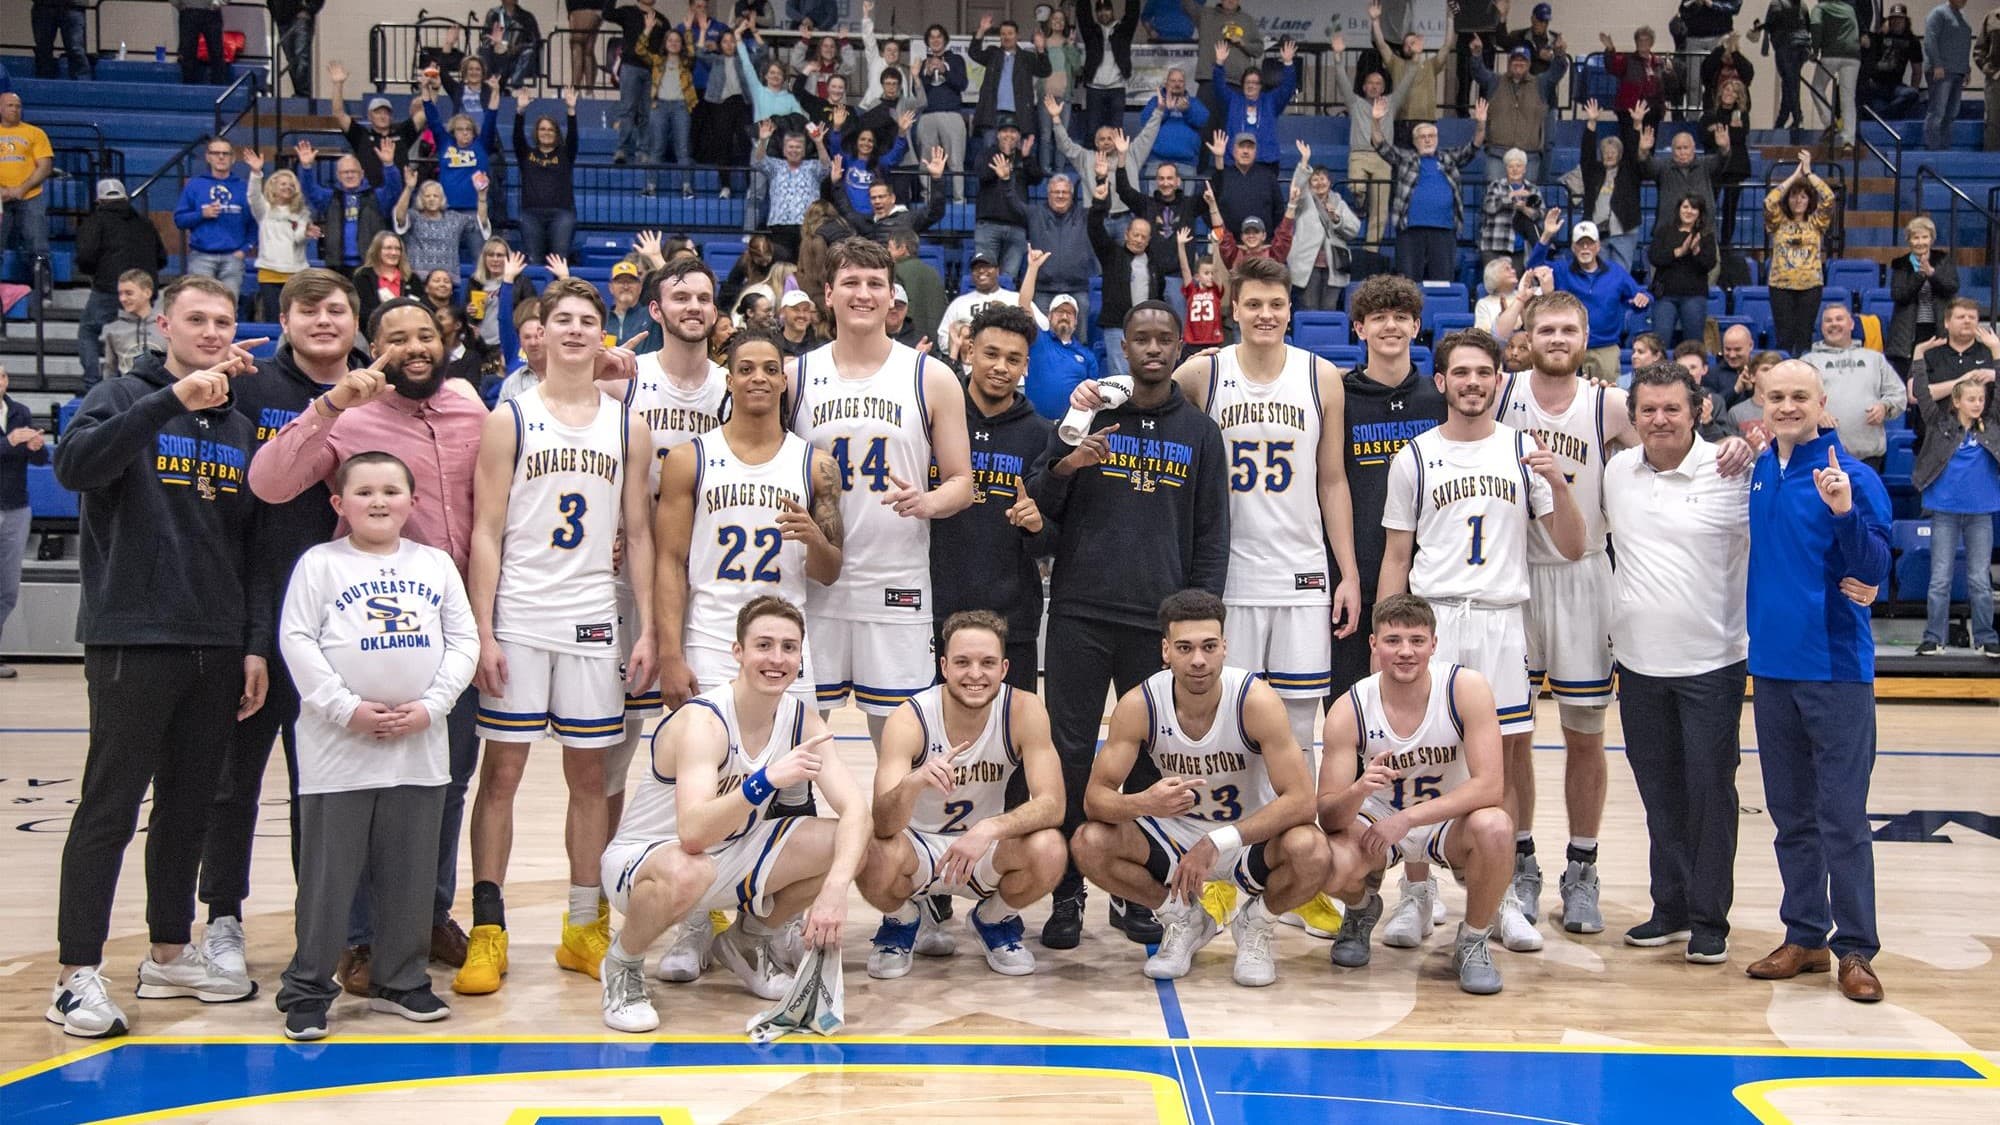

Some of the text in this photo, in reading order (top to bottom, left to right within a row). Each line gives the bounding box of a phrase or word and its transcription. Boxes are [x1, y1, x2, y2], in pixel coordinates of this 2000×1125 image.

[1271, 16, 1312, 31] Lane
[1190, 299, 1215, 322] 23
[639, 407, 721, 434] AVAGE STOR
[813, 396, 902, 428] SAVAGE STORM
[1220, 401, 1306, 431] SAVAGE STORM
[1107, 433, 1193, 466] OUTHEASTERN
[1353, 439, 1409, 456] BASKET
[1552, 431, 1588, 466] STORM
[526, 447, 618, 486] SAVAGE STORM
[832, 436, 890, 493] 44
[1099, 452, 1188, 478] ASKTALL
[1230, 440, 1296, 493] 55
[706, 483, 800, 515] SAVAGE STORM
[1432, 475, 1516, 511] SAVAGE STORM
[551, 492, 588, 550] 3
[716, 525, 783, 584] 22
[1466, 514, 1487, 566] 1
[335, 580, 441, 612] SOUTHEASTERN
[366, 596, 421, 634] SE
[360, 634, 431, 652] OKLAHOMA
[968, 760, 1004, 783] TORM
[1159, 750, 1246, 775] SAVAGE STORM
[1369, 745, 1457, 770] VAGE STORM
[1389, 774, 1443, 811] 15
[938, 799, 974, 833] 2
